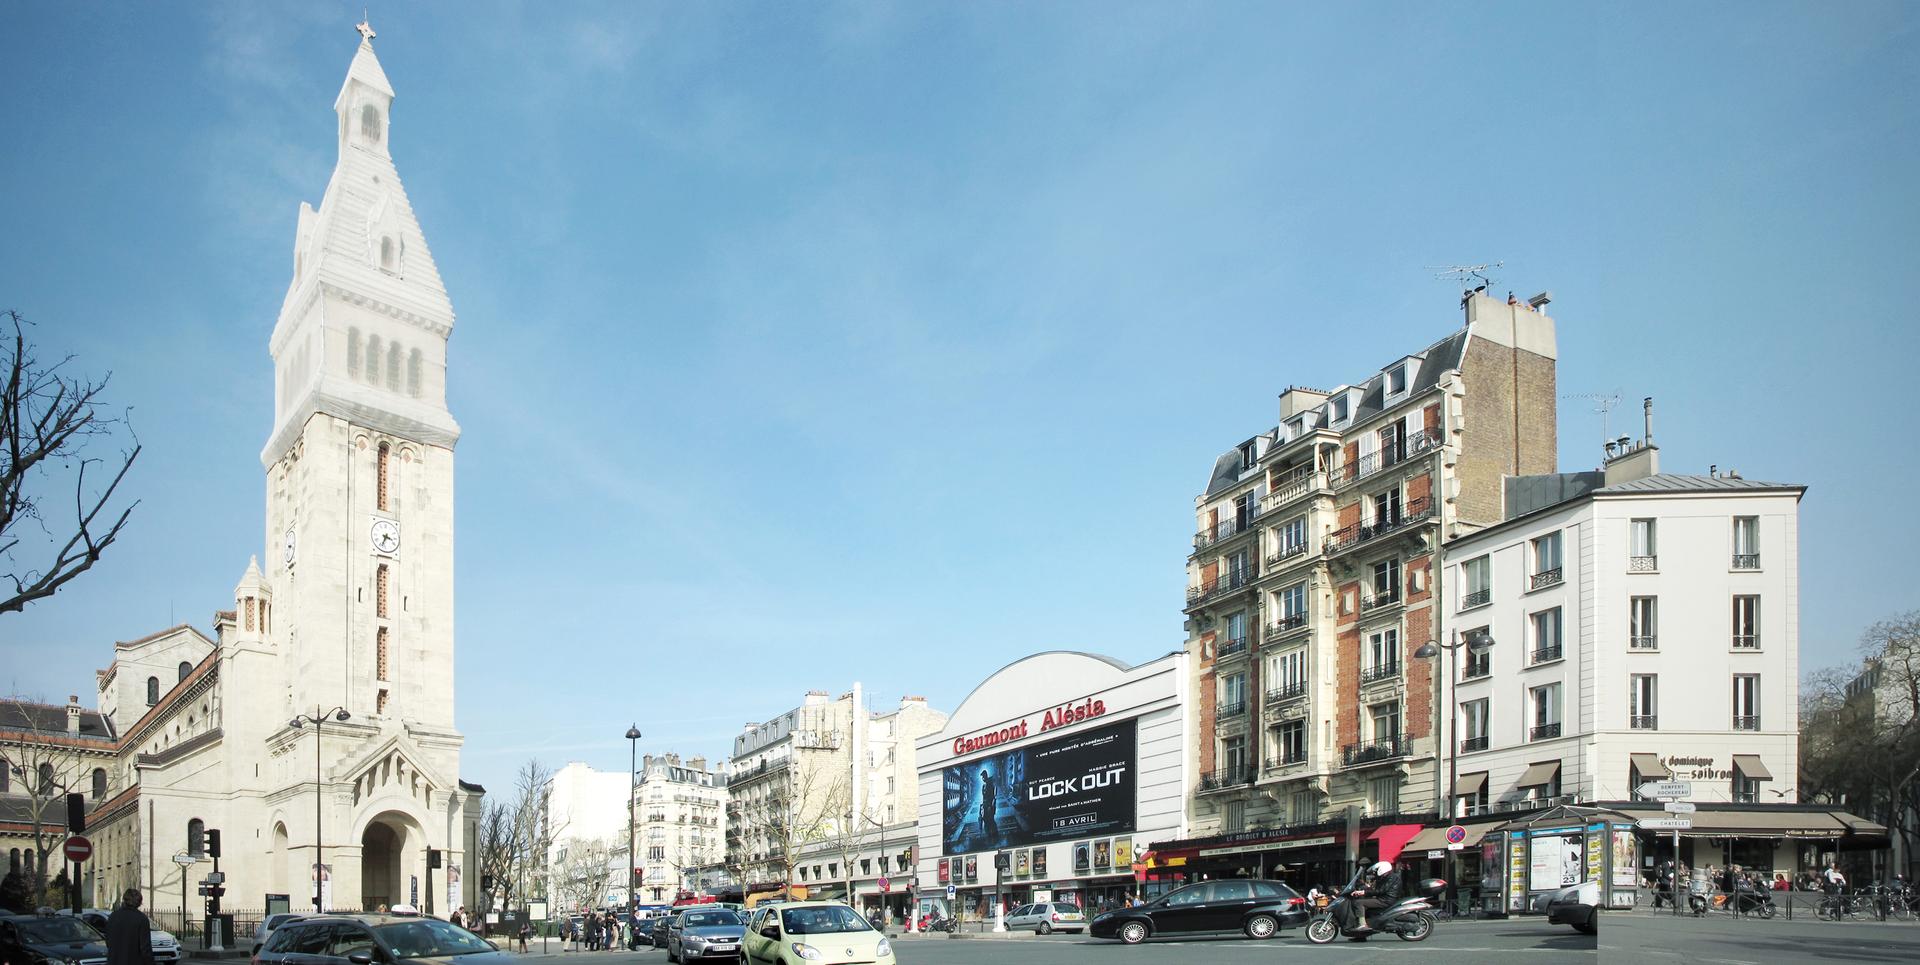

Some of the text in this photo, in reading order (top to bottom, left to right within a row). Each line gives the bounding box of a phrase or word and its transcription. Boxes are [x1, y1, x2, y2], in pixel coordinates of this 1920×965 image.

[953, 697, 1106, 755] Gaumont Alésia
[1088, 760, 1126, 773] MAGGIE GRACE
[1668, 755, 1714, 767] dominique
[1028, 767, 1126, 801] LOCK OUT
[1055, 820, 1066, 828] 18
[1068, 815, 1096, 826] AVRIL
[412, 878, 417, 891] P
[1562, 876, 1576, 884] 23
